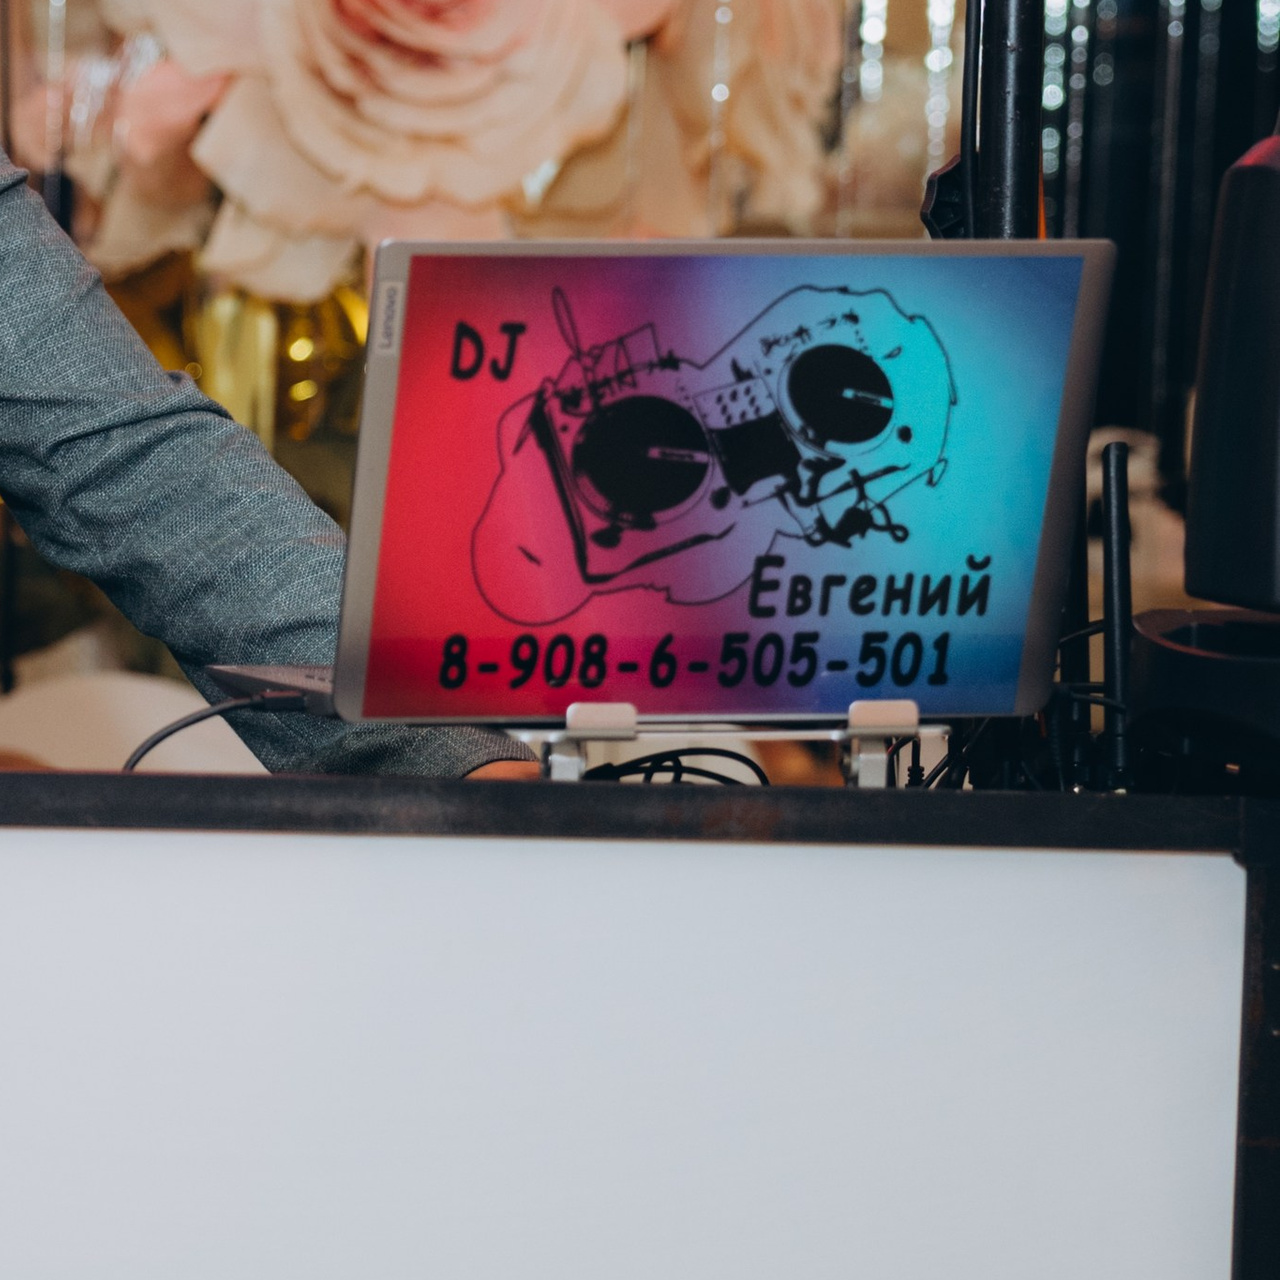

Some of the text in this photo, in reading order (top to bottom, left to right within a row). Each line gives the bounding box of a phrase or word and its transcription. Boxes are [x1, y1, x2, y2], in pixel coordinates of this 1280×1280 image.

[451, 321, 526, 382] DJ
[748, 554, 992, 618] Евгений
[439, 631, 950, 689] 8-908-6-505-501
